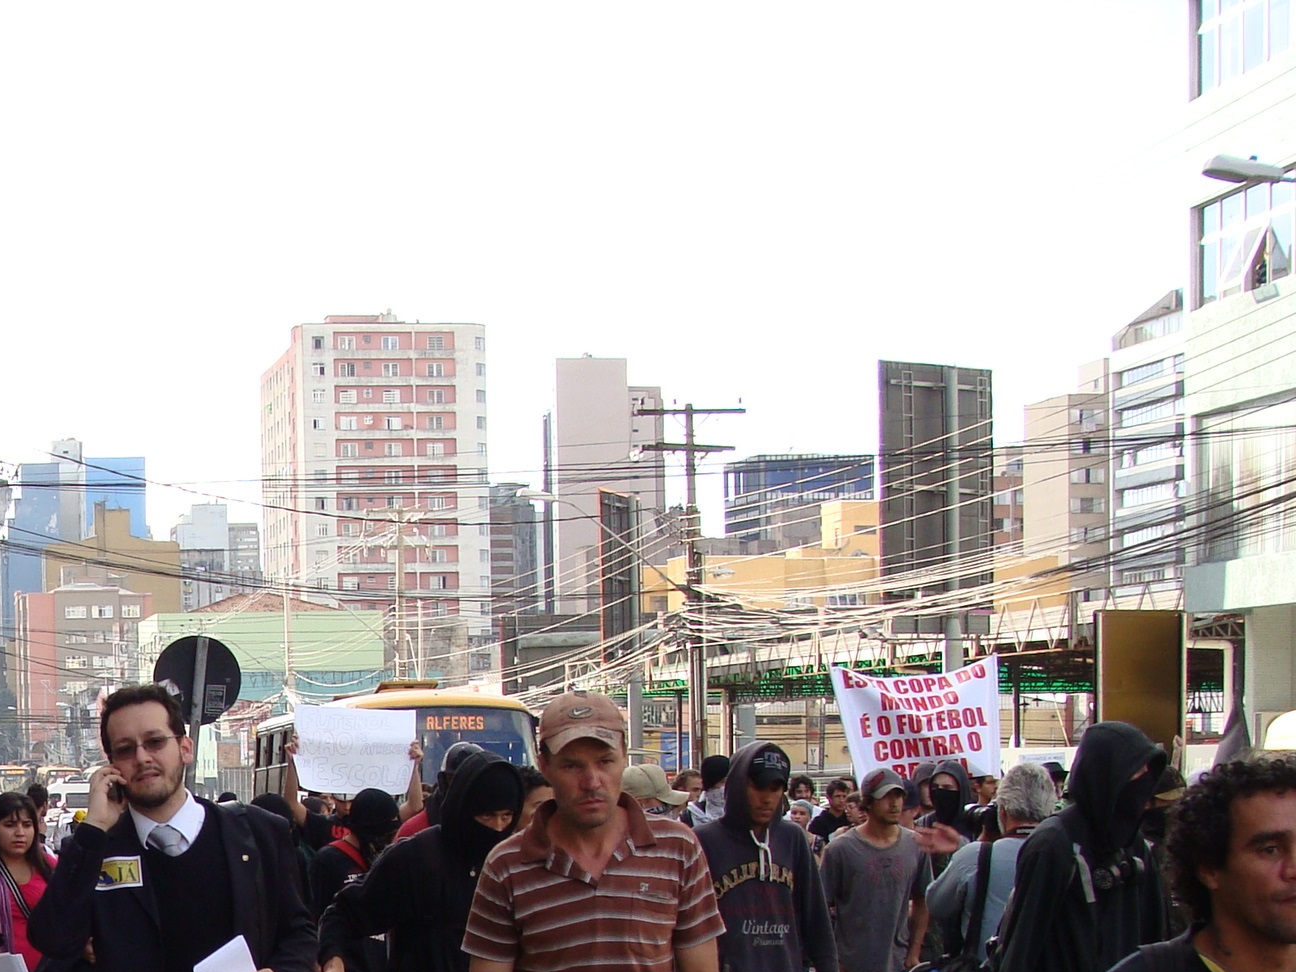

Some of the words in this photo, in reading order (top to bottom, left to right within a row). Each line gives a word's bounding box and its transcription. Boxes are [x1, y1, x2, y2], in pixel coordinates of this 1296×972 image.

[893, 676, 953, 695] COPA
[955, 663, 987, 684] DO
[879, 690, 960, 712] MUNDO
[426, 715, 485, 731] ALFERES
[859, 713, 873, 738] É
[876, 716, 892, 736] O
[896, 706, 988, 735] FUTEBOL
[873, 734, 965, 762] CONTRA
[966, 730, 983, 752] O
[312, 756, 411, 788] ESCOLA
[115, 862, 136, 883] JÁ
[742, 919, 791, 938] Vintage
